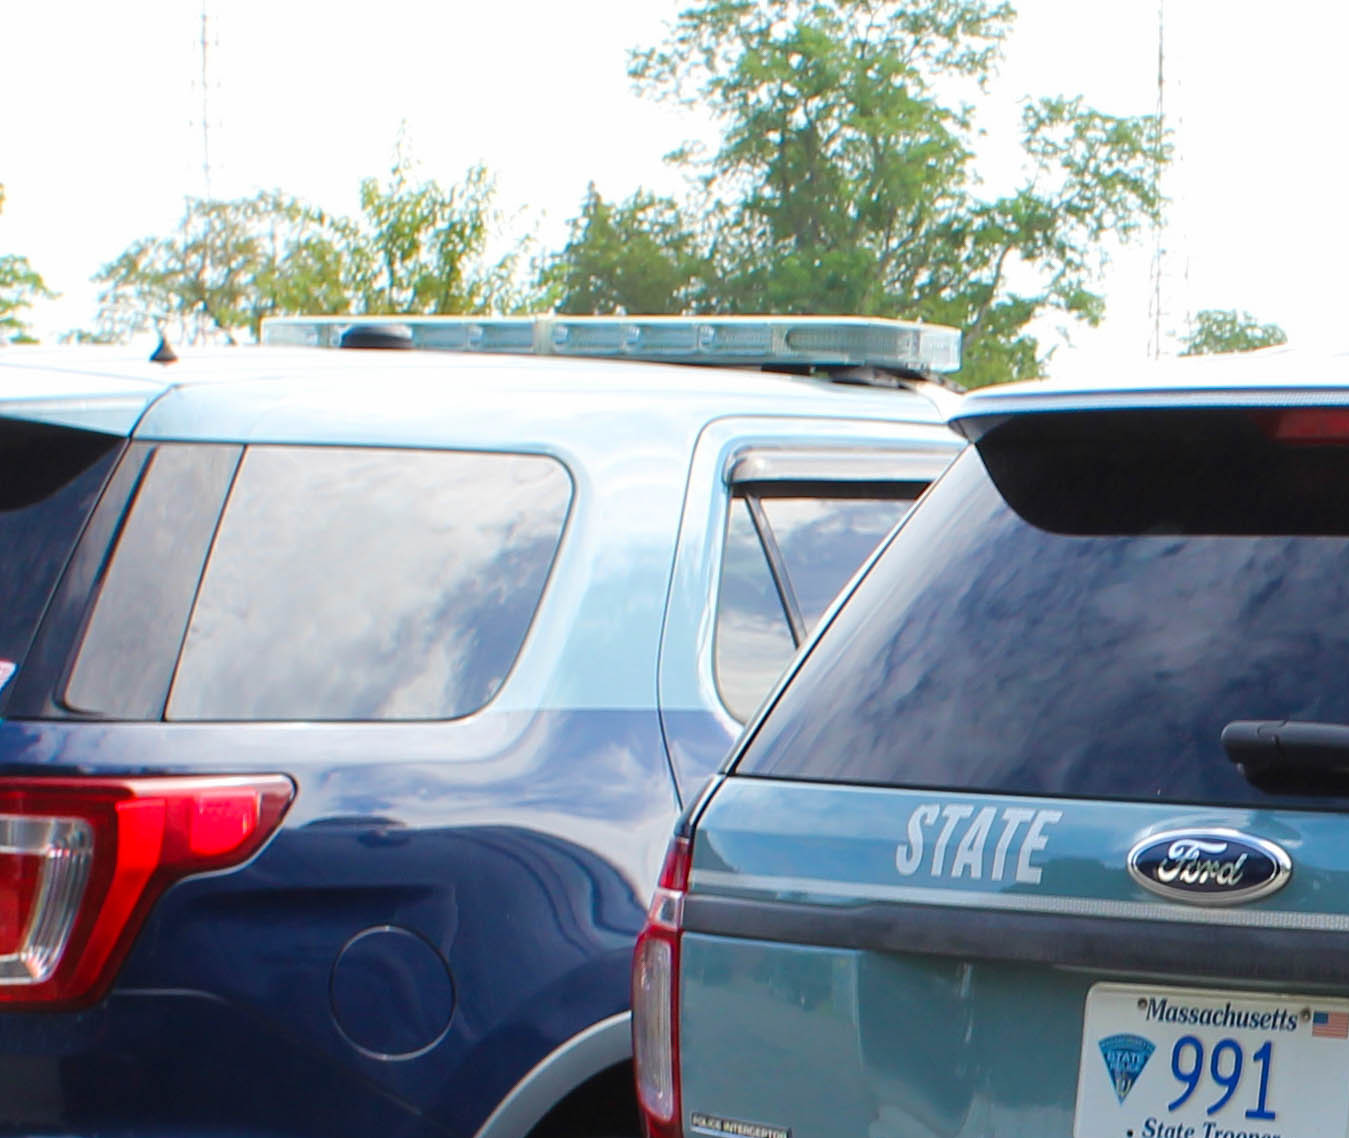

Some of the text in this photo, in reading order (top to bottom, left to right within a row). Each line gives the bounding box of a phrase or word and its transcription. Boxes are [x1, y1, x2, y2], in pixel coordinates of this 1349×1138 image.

[896, 803, 1062, 884] STATE
[1157, 838, 1249, 886] Ford
[1145, 998, 1298, 1031] Massachusetts
[1168, 1035, 1276, 1120] 991
